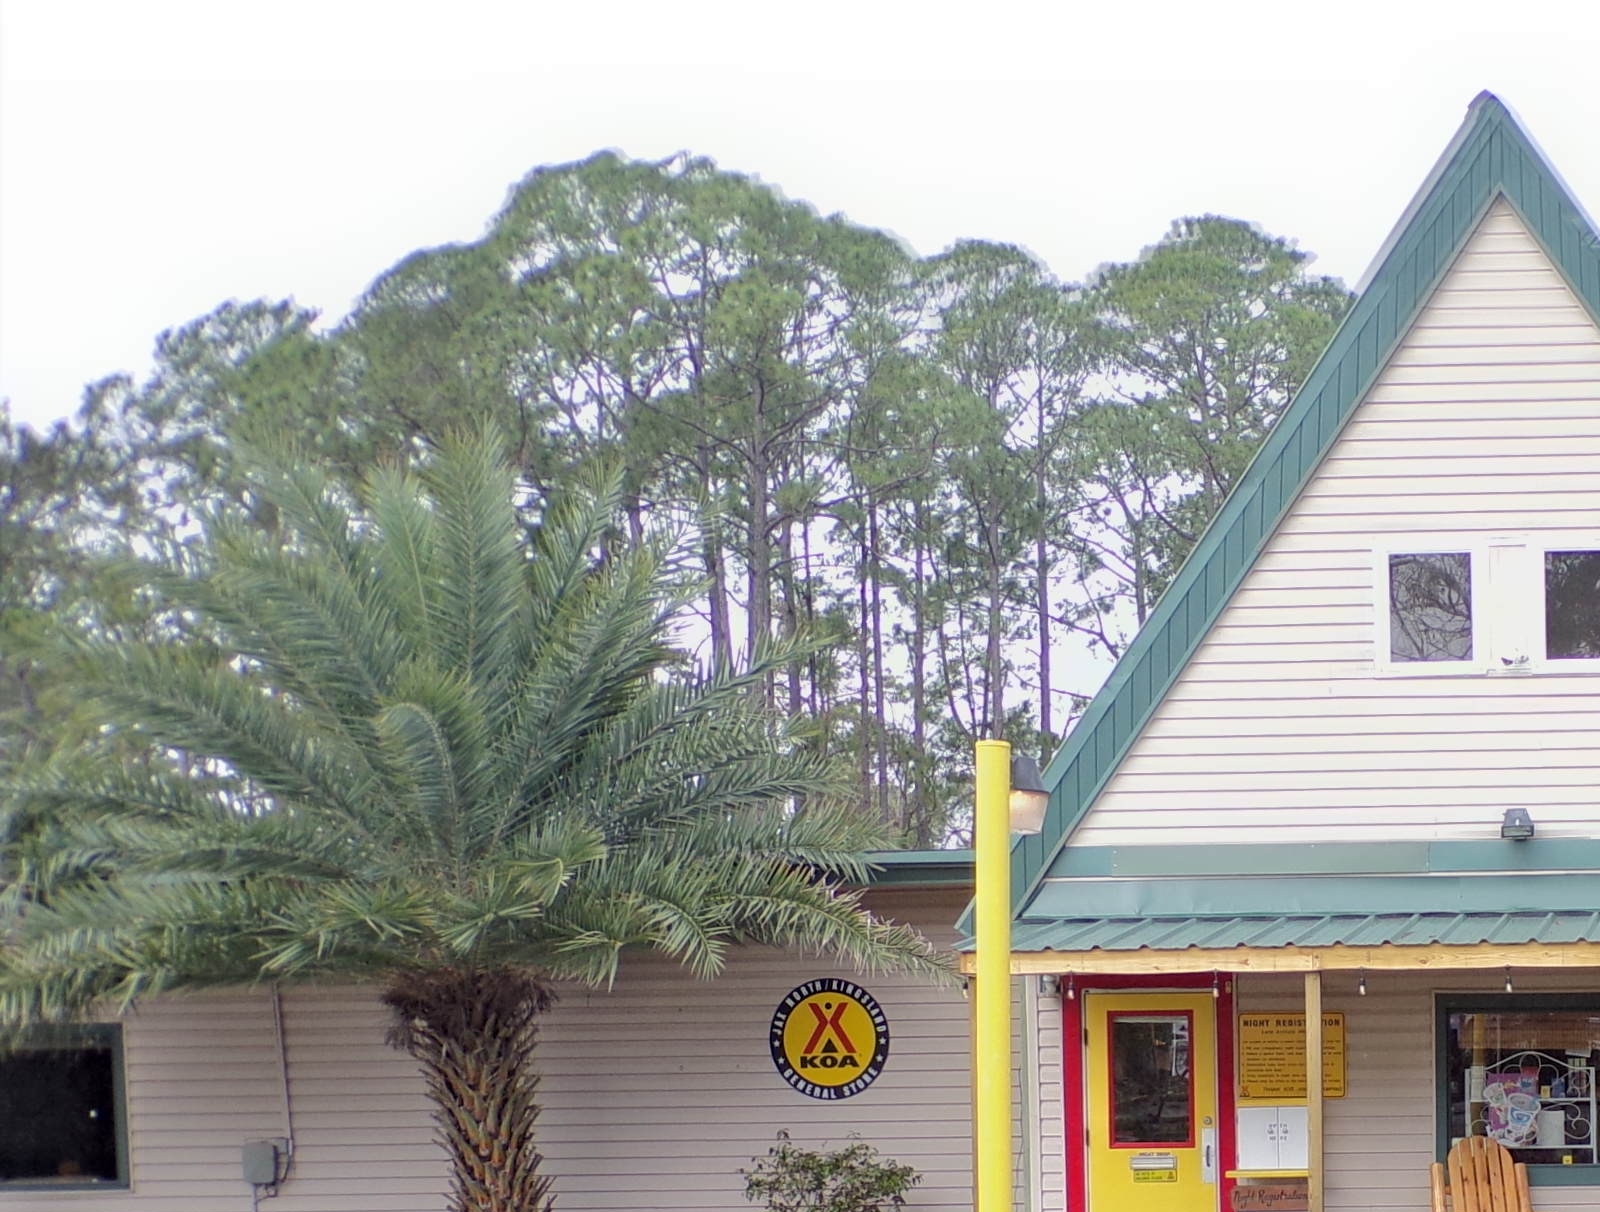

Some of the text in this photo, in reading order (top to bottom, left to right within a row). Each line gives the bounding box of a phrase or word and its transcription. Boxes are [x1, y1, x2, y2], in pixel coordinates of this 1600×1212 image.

[772, 1012, 787, 1036] JAX
[1242, 1018, 1341, 1027] NIGHT REGISTTION
[800, 1055, 860, 1069] KOA
[783, 1068, 878, 1099] GENERAL STORE
